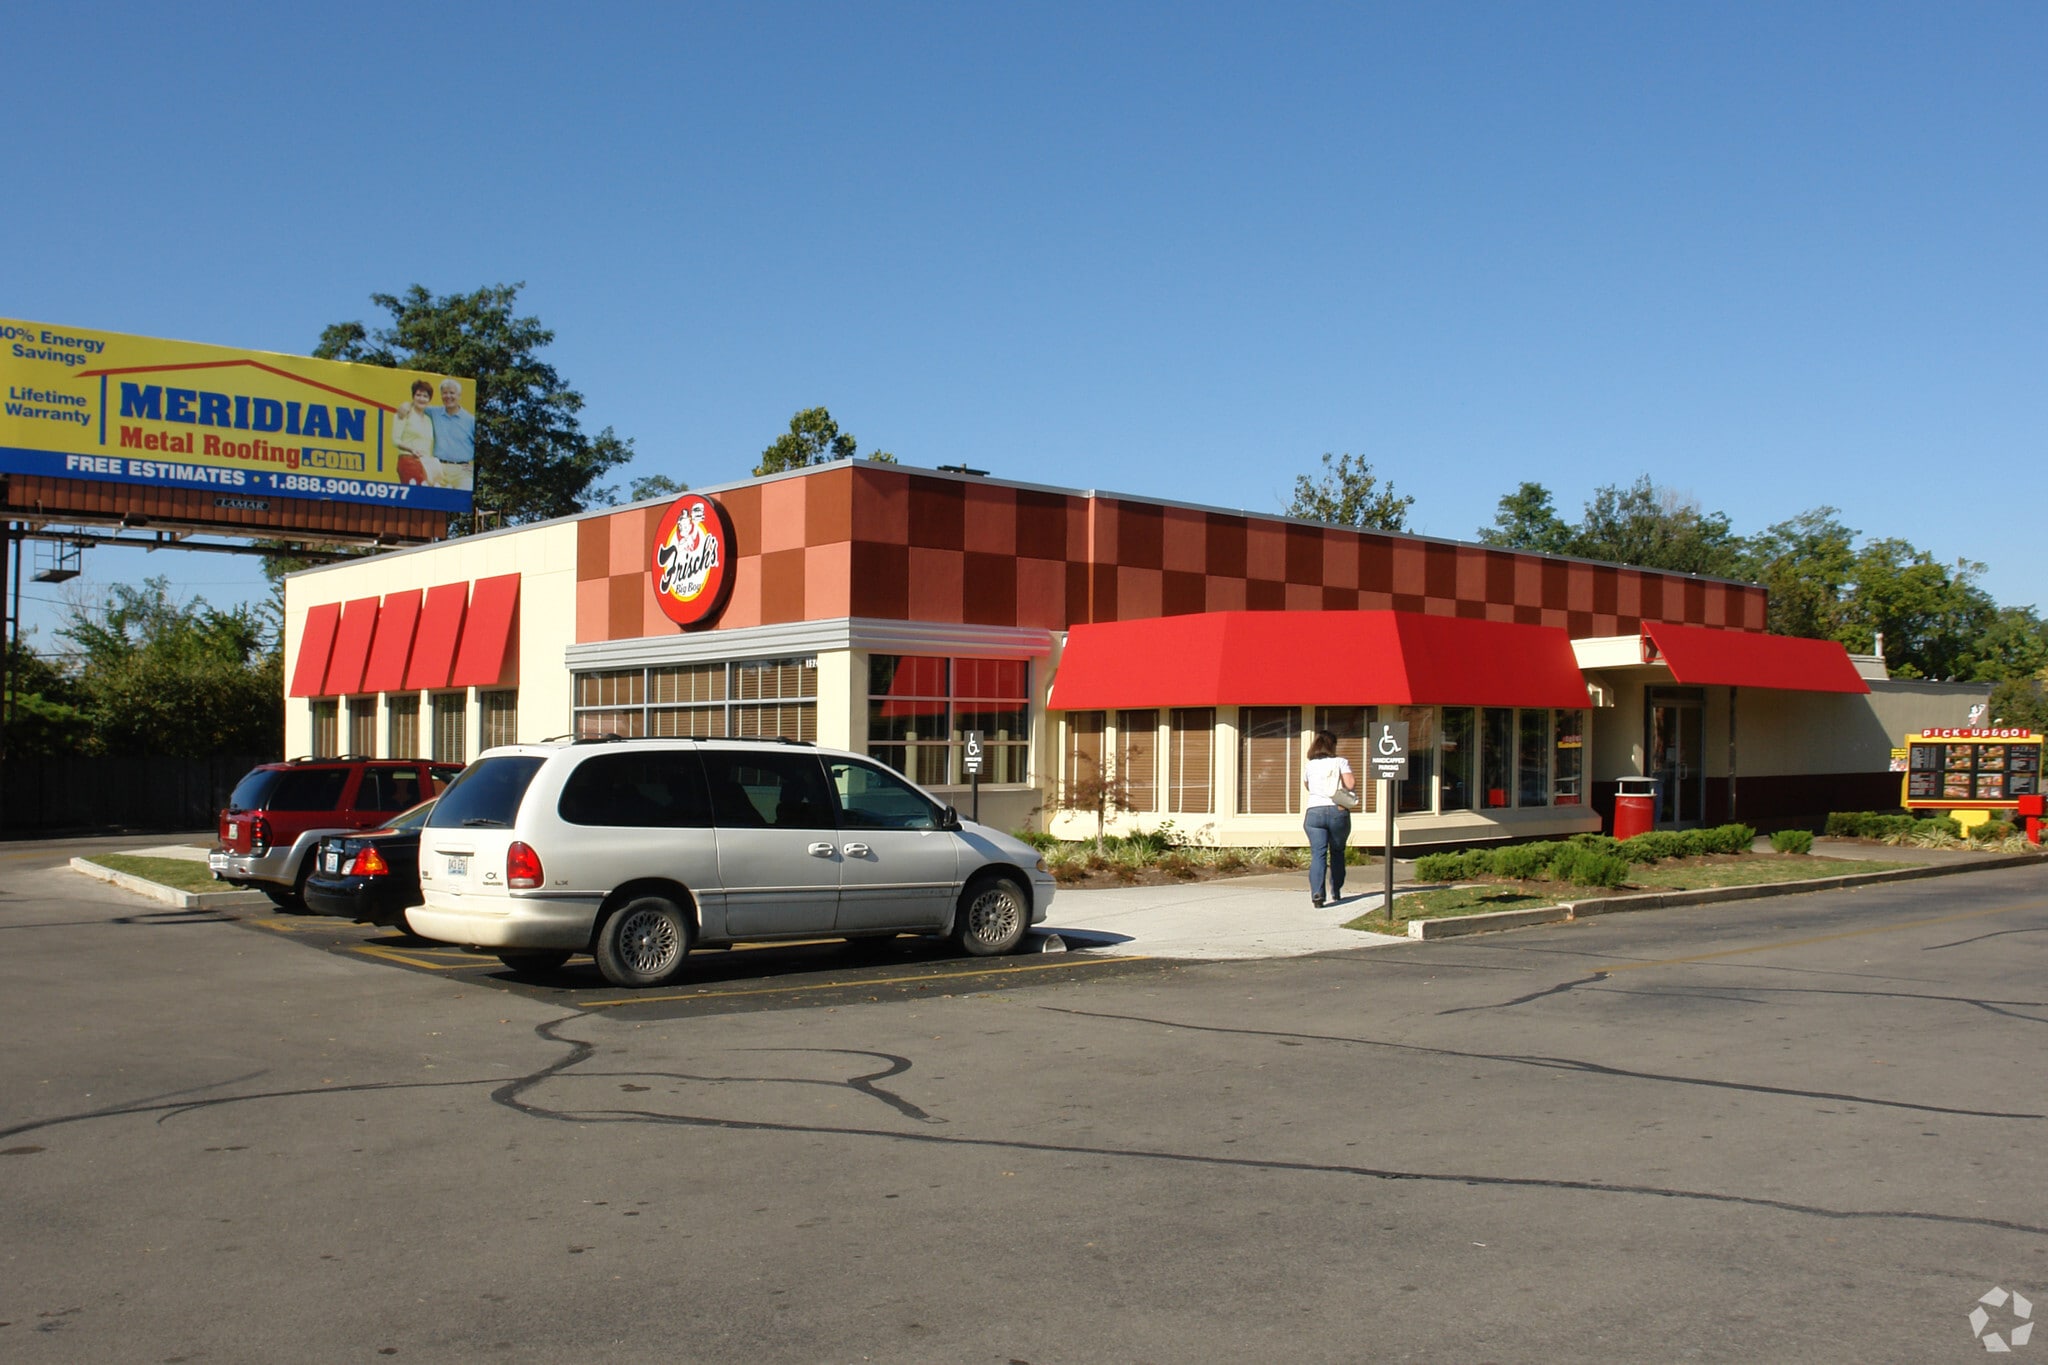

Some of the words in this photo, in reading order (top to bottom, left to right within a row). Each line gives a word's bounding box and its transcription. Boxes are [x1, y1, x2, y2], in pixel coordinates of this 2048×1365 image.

[40, 331, 105, 354] Energy
[12, 343, 87, 367] Savings
[10, 386, 87, 407] Lifetime
[5, 402, 91, 426] Warranty
[119, 382, 366, 442] MERIDIAN
[120, 426, 194, 454] Metal
[66, 455, 122, 475] FREE
[129, 460, 246, 486] ESTIMATES
[269, 474, 410, 500] 1.888.900.0977
[220, 498, 265, 511] LAMAR
[658, 534, 718, 593] Frisch's
